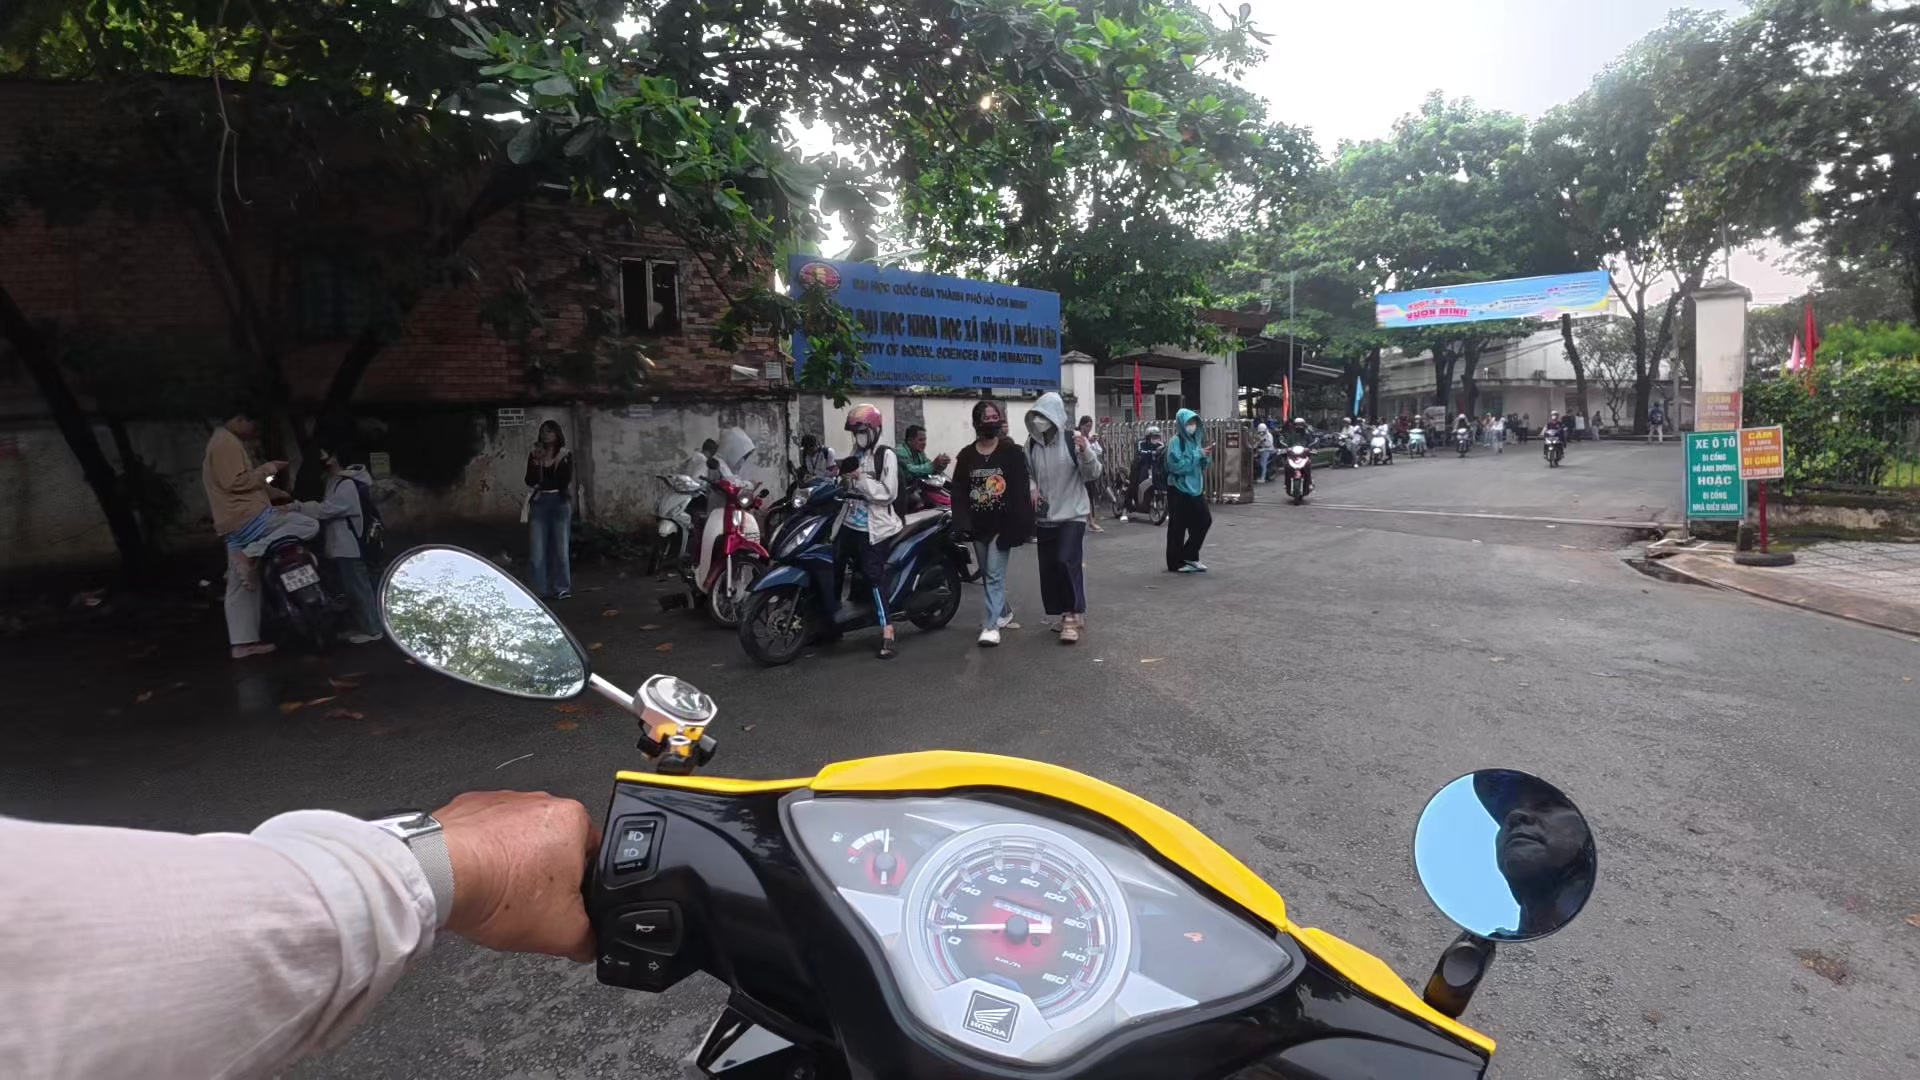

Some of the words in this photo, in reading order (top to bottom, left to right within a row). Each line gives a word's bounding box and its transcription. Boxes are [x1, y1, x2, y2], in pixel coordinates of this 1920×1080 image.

[893, 282, 918, 296] QUỐC
[921, 288, 934, 299] GIA
[880, 311, 905, 341] HỌC
[907, 314, 937, 338] KHOA
[940, 316, 962, 344] HỌC
[965, 315, 978, 342] XÃ
[981, 316, 997, 348] HỘI
[999, 318, 1012, 345] VÀ
[887, 344, 899, 356] OF
[902, 344, 934, 358] SOCIAL
[937, 346, 978, 361] SCIENCES
[981, 350, 997, 362] AND
[999, 351, 1043, 365] HUMANITIES
[1696, 439, 1709, 449] XE
[1712, 437, 1719, 448] Ô
[1722, 436, 1736, 448] TÔ
[1698, 474, 1732, 487] HOẶC
[987, 874, 1007, 885] 60
[1020, 877, 1040, 888] 80
[961, 886, 981, 896] 40
[1044, 891, 1067, 902] 100
[948, 911, 968, 922] 20
[1064, 918, 1086, 929] 120
[948, 936, 961, 945] 0
[1062, 950, 1086, 962] 140
[1042, 973, 1067, 985] 160
[970, 1021, 1006, 1037] HONDA
